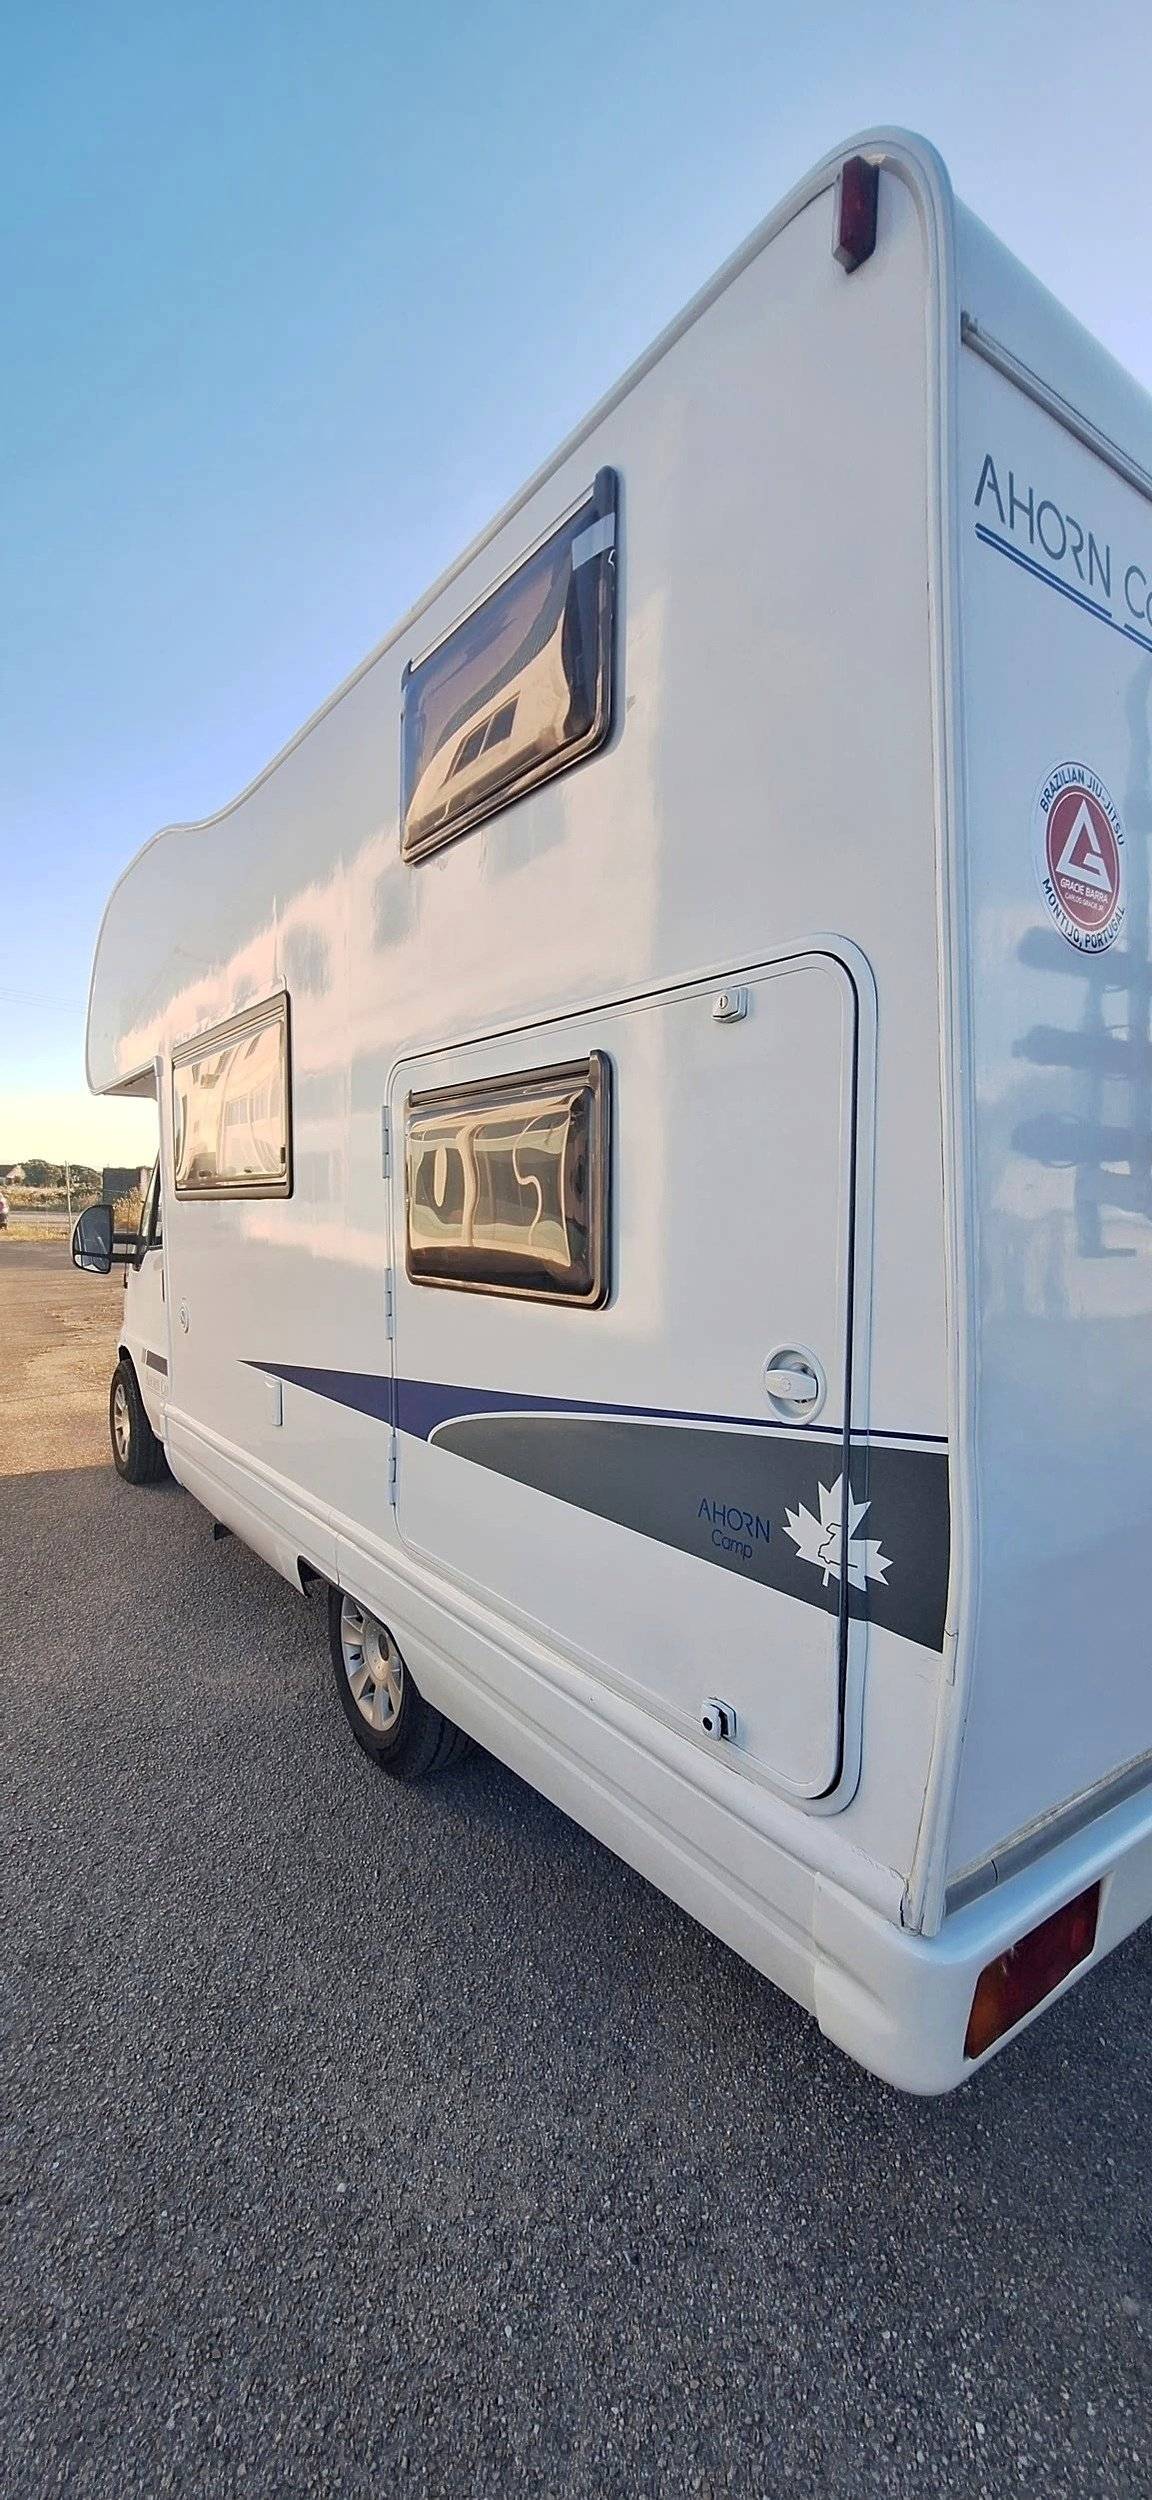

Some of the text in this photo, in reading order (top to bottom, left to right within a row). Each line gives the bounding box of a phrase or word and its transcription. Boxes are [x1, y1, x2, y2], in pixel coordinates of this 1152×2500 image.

[974, 453, 1111, 598] AHORN
[1040, 767, 1124, 845] BRAZILIAN JIU-JITSU
[1042, 878, 1125, 948] MONTIJO, PORTUGAL
[1085, 887, 1109, 904] BARRA
[698, 1498, 770, 1543] AHORN
[711, 1529, 753, 1560] Camp
